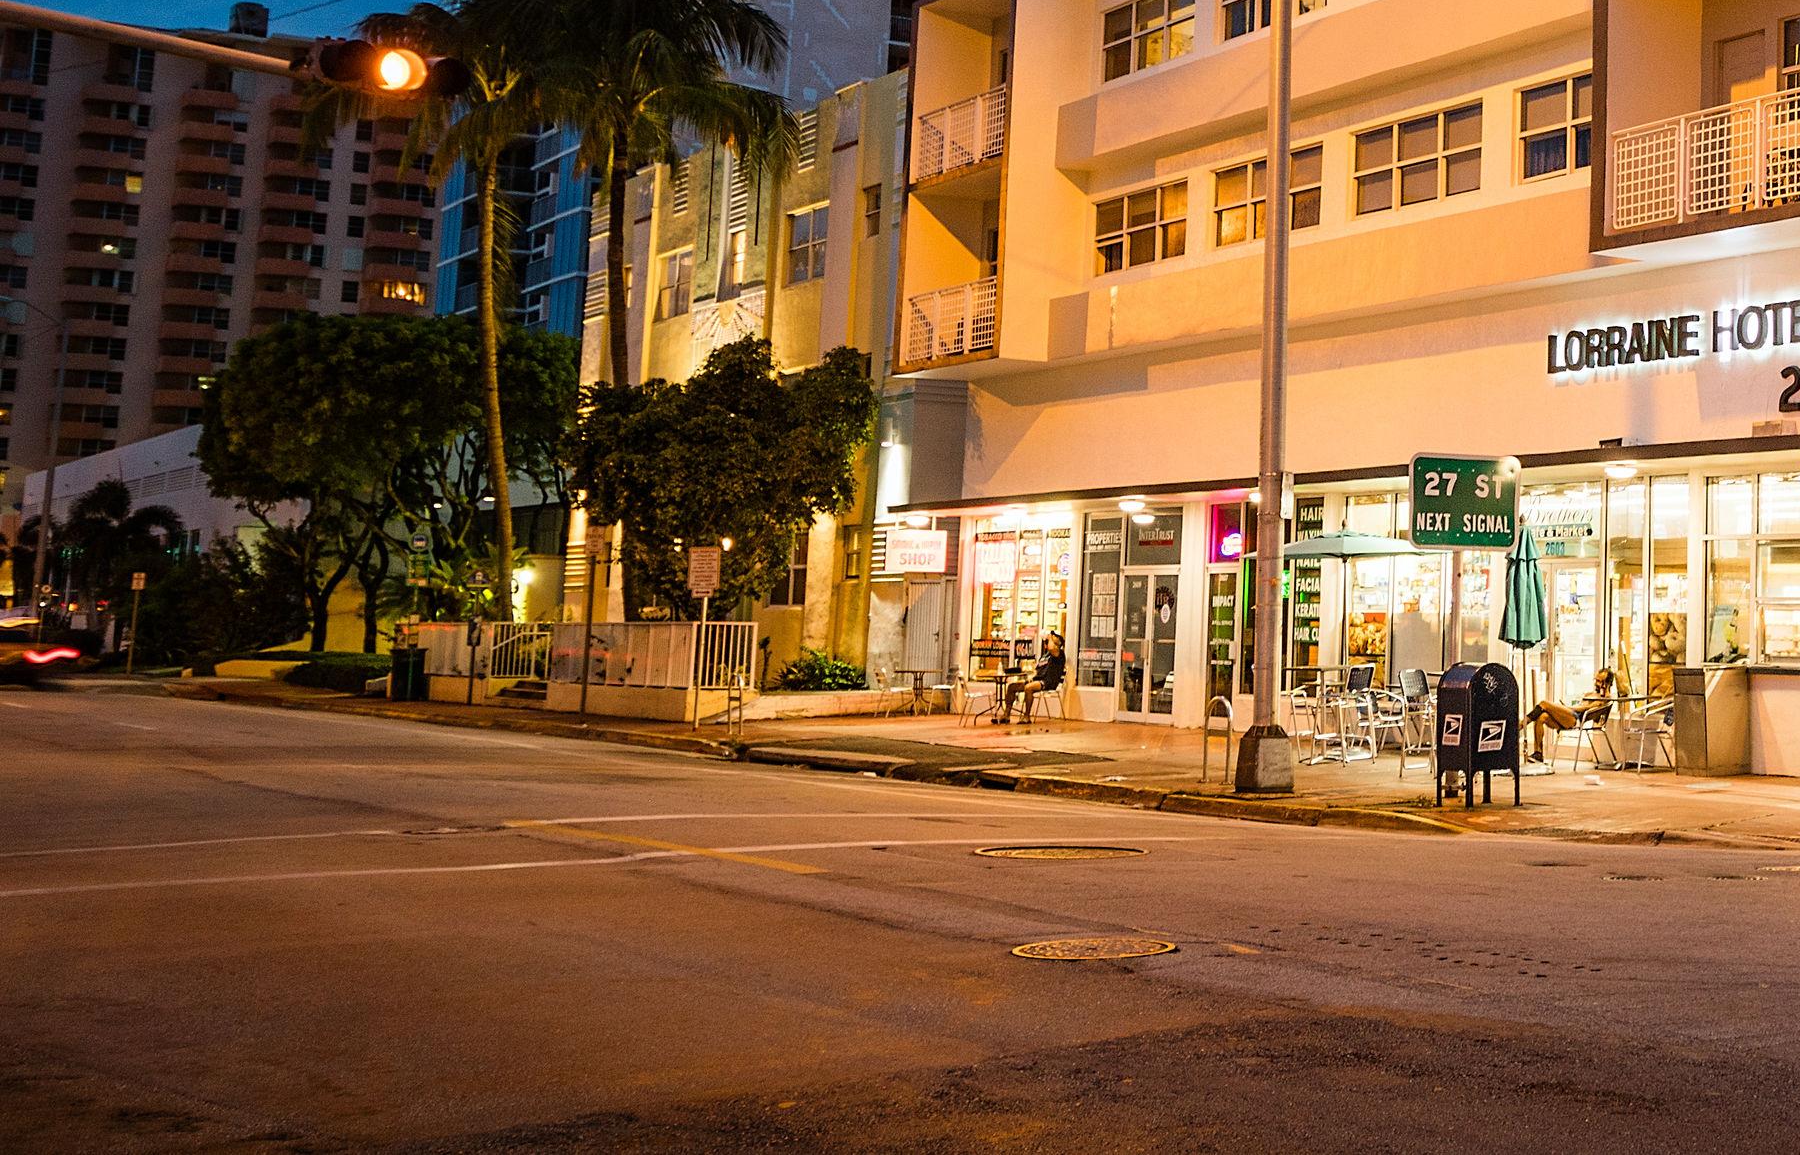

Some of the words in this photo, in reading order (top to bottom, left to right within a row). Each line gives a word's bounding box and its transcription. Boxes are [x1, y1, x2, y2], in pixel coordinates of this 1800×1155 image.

[1547, 315, 1700, 374] LORRAINE
[1424, 472, 1458, 497] 27
[1475, 474, 1508, 499] ST
[1416, 512, 1451, 532] NEXT
[1463, 513, 1511, 533] SIGNAL
[1555, 525, 1588, 538] Market
[899, 552, 936, 566] SHOP
[1294, 627, 1310, 641] HAIR
